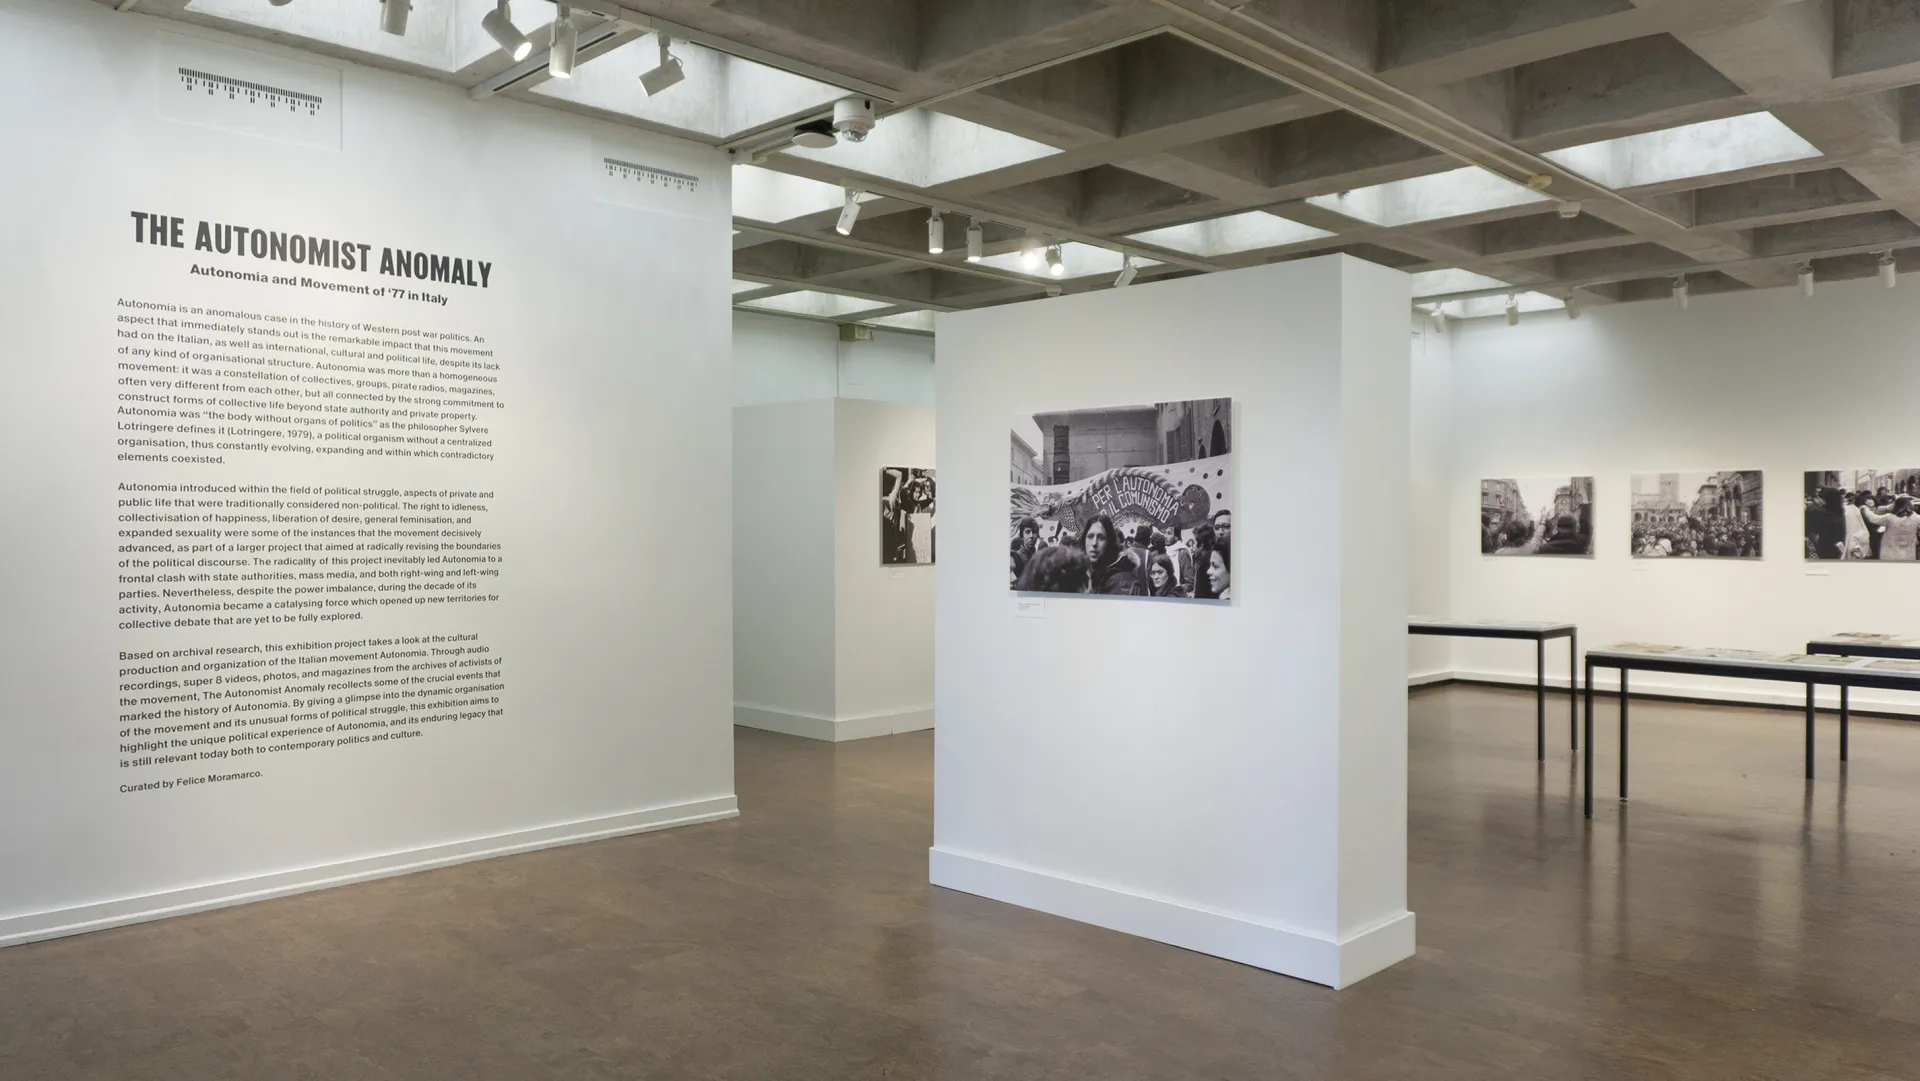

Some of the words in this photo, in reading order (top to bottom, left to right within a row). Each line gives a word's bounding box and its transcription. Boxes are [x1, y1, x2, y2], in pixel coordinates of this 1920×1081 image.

[131, 211, 184, 249] THE
[195, 220, 371, 273] AUTONOMIST
[379, 247, 492, 289] ANOMALY
[190, 264, 268, 283] Autonomia
[272, 276, 297, 286] and
[301, 277, 370, 295] Movement
[372, 287, 385, 297] of
[408, 290, 419, 301] in
[422, 292, 448, 307] Italy
[117, 298, 177, 312] Autonomia
[179, 304, 188, 314] is
[190, 307, 204, 315] an
[206, 308, 262, 321] anomalous
[264, 314, 288, 324] case
[289, 316, 299, 325] in
[301, 317, 316, 327] the
[318, 318, 350, 331] history
[351, 322, 361, 331] of
[362, 323, 400, 335] Western
[401, 329, 421, 337] post
[422, 331, 438, 339] war
[439, 332, 472, 343] politics.
[473, 335, 485, 343] An
[117, 328, 138, 339] had
[140, 332, 155, 341] on
[157, 332, 175, 342] the
[177, 334, 213, 347] Italian,
[215, 339, 227, 347] as
[229, 340, 250, 349] well
[252, 342, 264, 350] as
[266, 342, 329, 357] international,
[330, 349, 365, 359] cultural
[367, 352, 384, 361] and
[386, 354, 421, 364] political
[422, 356, 438, 367] life,
[439, 358, 471, 369] despite
[472, 361, 482, 369] its
[483, 362, 500, 371] lack
[118, 393, 170, 404] construct
[173, 395, 204, 405] forms
[206, 397, 216, 406] of
[218, 398, 267, 409] collective
[269, 400, 285, 410] life
[287, 401, 322, 413] beyond
[324, 404, 348, 414] state
[349, 406, 390, 417] authority
[391, 408, 408, 417] and
[409, 409, 439, 419] private
[440, 412, 477, 422] property.
[117, 421, 174, 434] Lotringere
[176, 424, 216, 435] defines
[218, 425, 225, 435] it
[227, 426, 285, 439] (Lotringere,
[287, 429, 315, 441] 1979),
[324, 432, 361, 441] political
[363, 434, 405, 444] organism
[406, 436, 439, 445] without
[447, 438, 492, 447] centralized
[117, 452, 169, 463] elements
[171, 454, 226, 464] coexisted.
[118, 482, 178, 493] Autonomia
[180, 483, 236, 493] introduced
[238, 484, 269, 494] within
[271, 485, 288, 494] the
[290, 485, 311, 495] field
[312, 486, 323, 495] of
[324, 487, 361, 497] political
[363, 488, 402, 498] struggle,
[403, 489, 438, 498] aspects
[439, 489, 448, 498] of
[449, 490, 477, 499] private
[479, 491, 494, 499] and
[1091, 484, 1113, 509] PER
[118, 513, 200, 523] collectivisation
[202, 513, 213, 523] of
[215, 513, 270, 524] happiness,
[272, 513, 318, 523] liberation
[319, 514, 330, 523] of
[331, 514, 363, 525] desire,
[364, 515, 398, 525] general
[399, 515, 455, 525] feminisation,
[456, 516, 472, 524] and
[1108, 501, 1120, 516] IL
[1117, 491, 1171, 523] COMUNISMO
[118, 543, 175, 553] advanced,
[177, 545, 190, 553] as
[192, 543, 213, 554] part
[215, 543, 226, 552] of
[236, 543, 266, 554] larger
[268, 542, 302, 553] project
[304, 543, 323, 552] that
[325, 542, 354, 551] aimed
[355, 542, 365, 551] at
[366, 542, 404, 552] radically
[405, 542, 439, 552] revising
[441, 542, 455, 551] the
[456, 542, 501, 550] boundaries
[119, 589, 160, 601] parties.
[162, 587, 234, 598] Nevertheless,
[236, 586, 274, 597] despite
[276, 586, 292, 595] the
[294, 586, 324, 596] power
[326, 584, 376, 593] imbalance,
[377, 583, 406, 593] during
[408, 582, 422, 591] the
[423, 582, 455, 591] decade
[456, 581, 465, 590] of
[466, 581, 477, 589] its
[119, 650, 154, 661] Based
[156, 651, 170, 659] on
[172, 646, 214, 658] archival
[216, 644, 263, 655] research,
[265, 643, 284, 653] this
[285, 641, 333, 652] exhibition
[334, 639, 366, 650] project
[368, 638, 393, 647] takes
[401, 636, 420, 645] look
[421, 635, 430, 644] at
[432, 635, 446, 643] the
[447, 633, 478, 642] cultural
[119, 697, 138, 707] the
[140, 692, 200, 705] movement,
[202, 691, 222, 700] The
[224, 686, 282, 699] Autonomist
[284, 683, 326, 694] Anomaly
[327, 680, 373, 691] recollects
[374, 678, 399, 687] some
[400, 676, 410, 685] of
[411, 675, 425, 685] the
[426, 673, 455, 683] crucial
[456, 671, 484, 681] events
[485, 670, 501, 679] that
[119, 728, 130, 738] of
[133, 727, 152, 736] the
[154, 721, 211, 734] movement
[212, 719, 232, 729] and
[234, 718, 247, 728] its
[249, 714, 288, 726] unusual
[290, 713, 318, 722] forms
[319, 710, 330, 720] of
[331, 707, 368, 720] political
[369, 704, 408, 715] struggle,
[410, 702, 426, 711] this
[427, 699, 469, 710] exhibition
[469, 697, 490, 706] aims
[491, 696, 499, 704] to
[120, 780, 160, 793] Curated
[162, 780, 174, 789] by
[176, 776, 206, 787] Felice
[208, 771, 263, 783] Moramarco.
